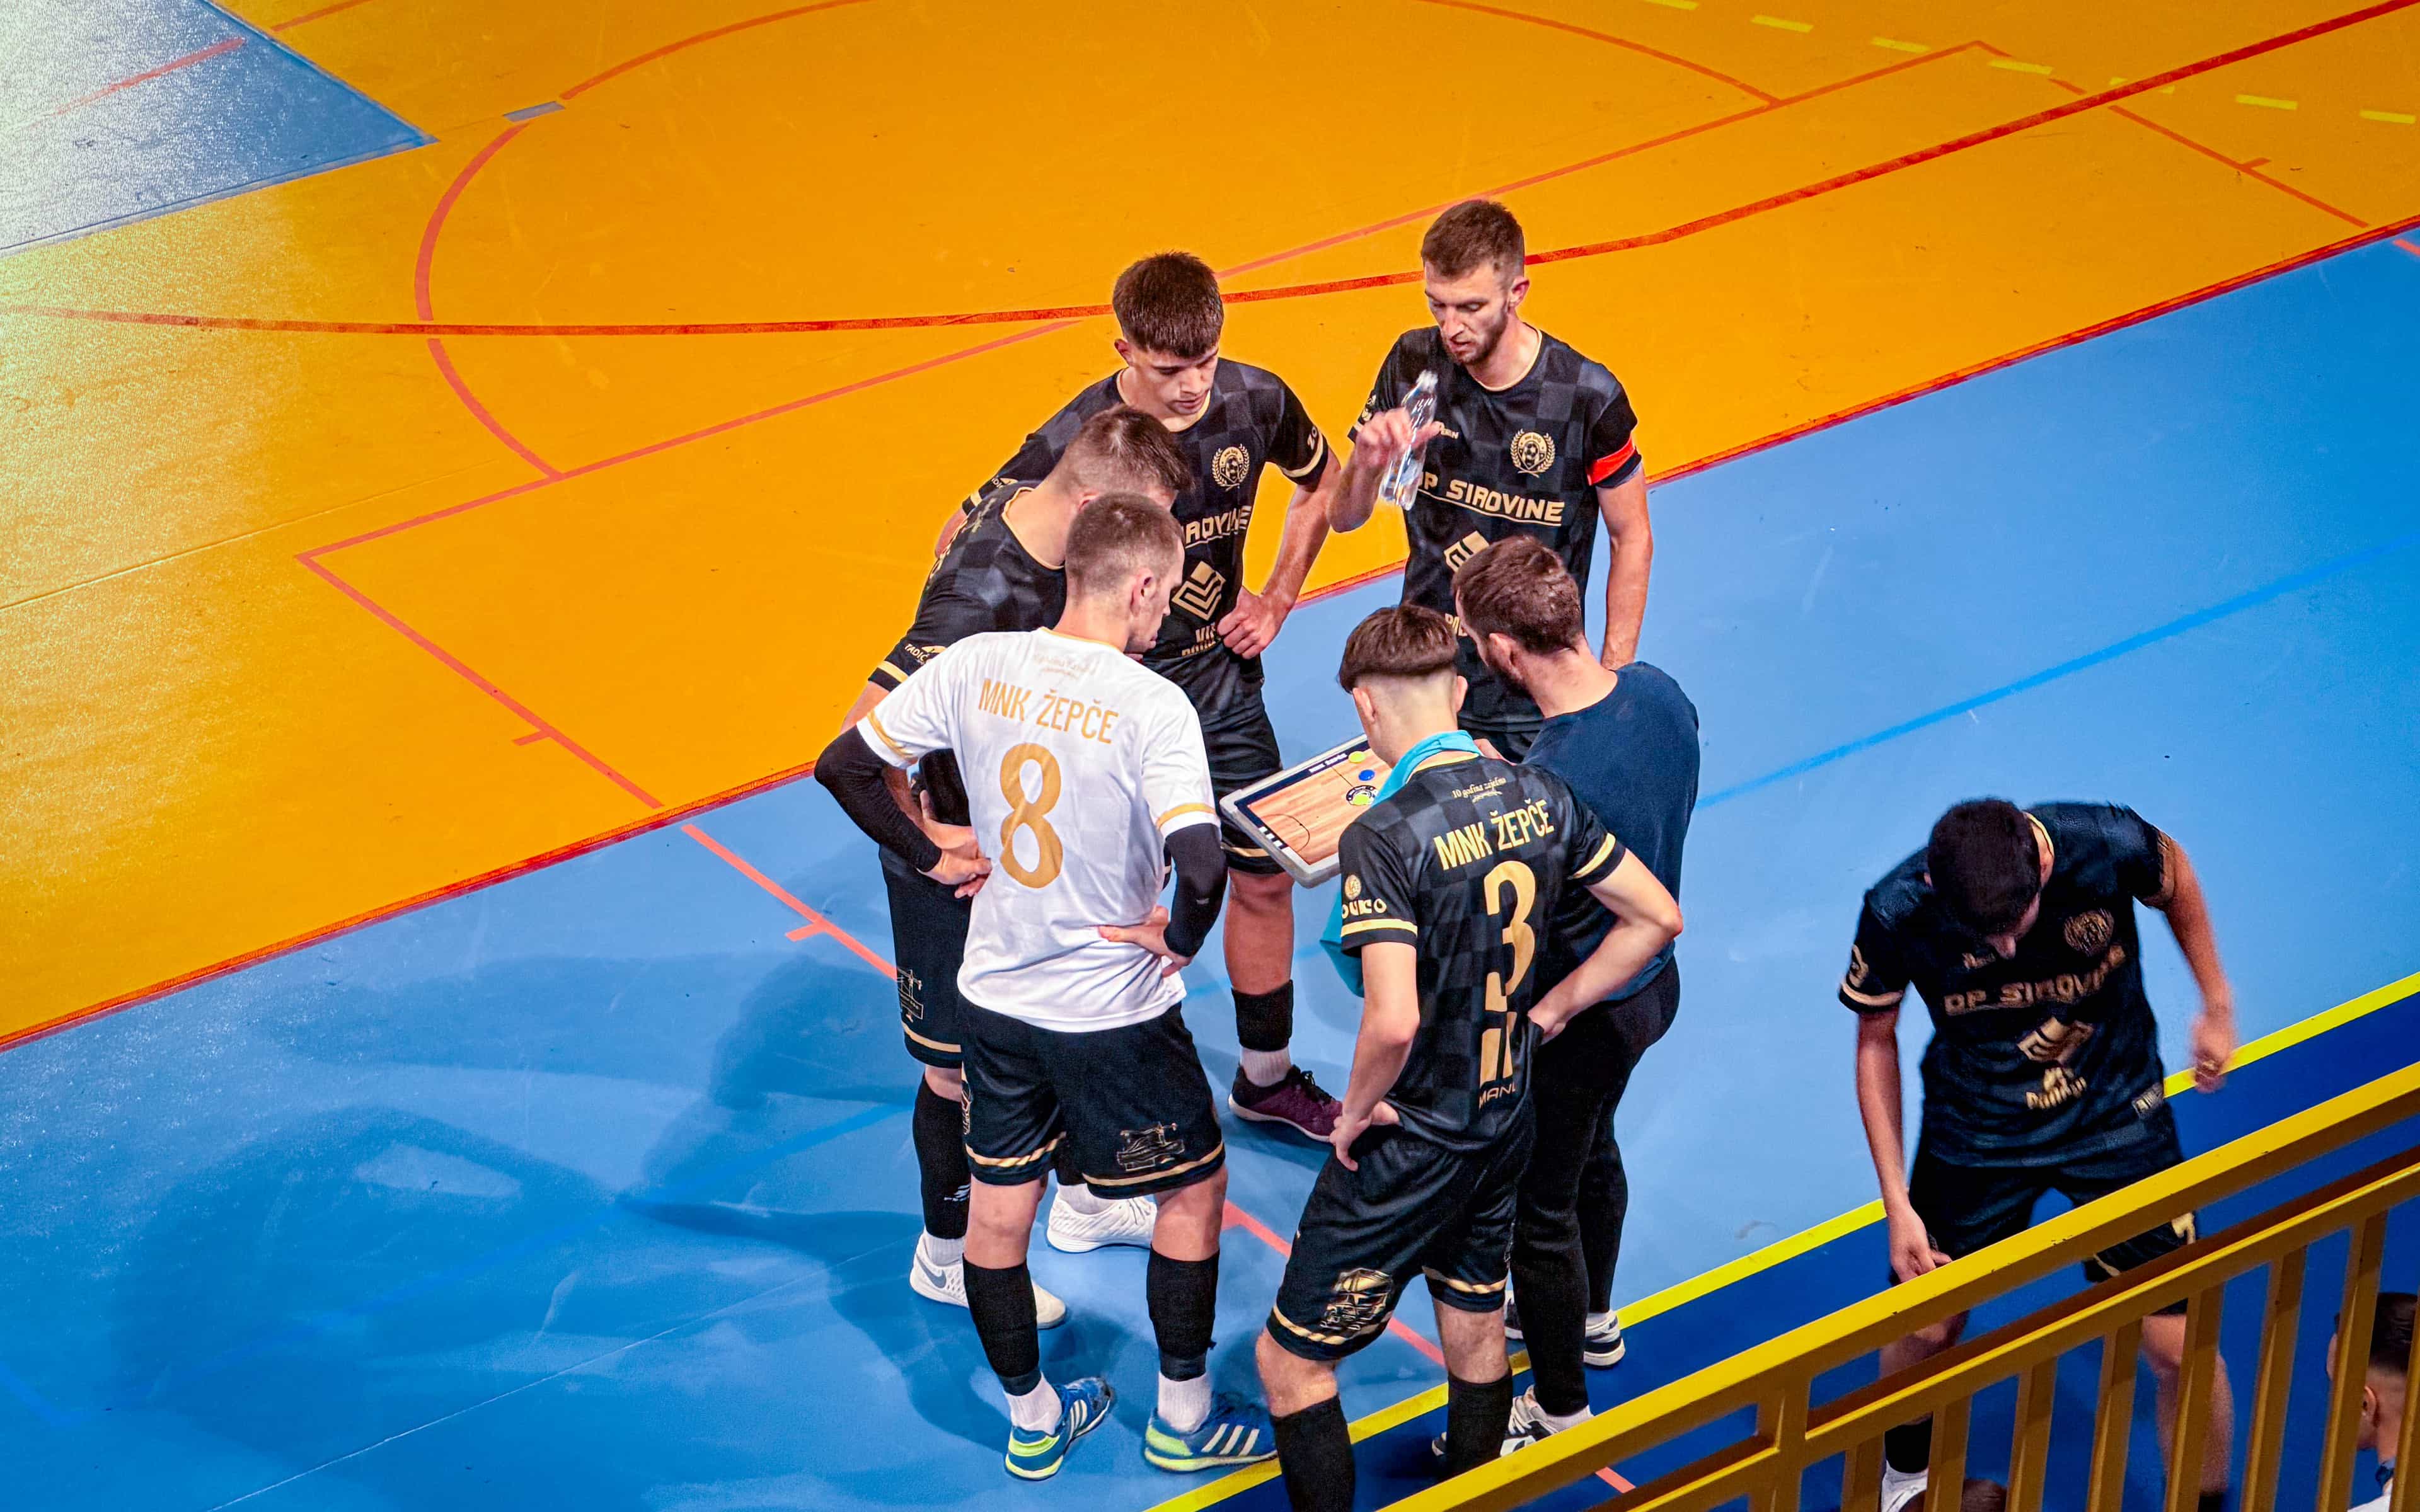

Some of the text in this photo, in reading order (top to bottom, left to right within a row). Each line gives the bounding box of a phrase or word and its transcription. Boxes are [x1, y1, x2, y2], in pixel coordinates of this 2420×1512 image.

[1185, 505, 1252, 544] ROVINE
[1418, 471, 1565, 522] P SIROVINE
[978, 679, 1119, 745] MNK ŽEPČE
[1000, 742, 1063, 888] 8
[1434, 798, 1555, 871] MNK ŽEPČE
[1484, 861, 1536, 1012] 3
